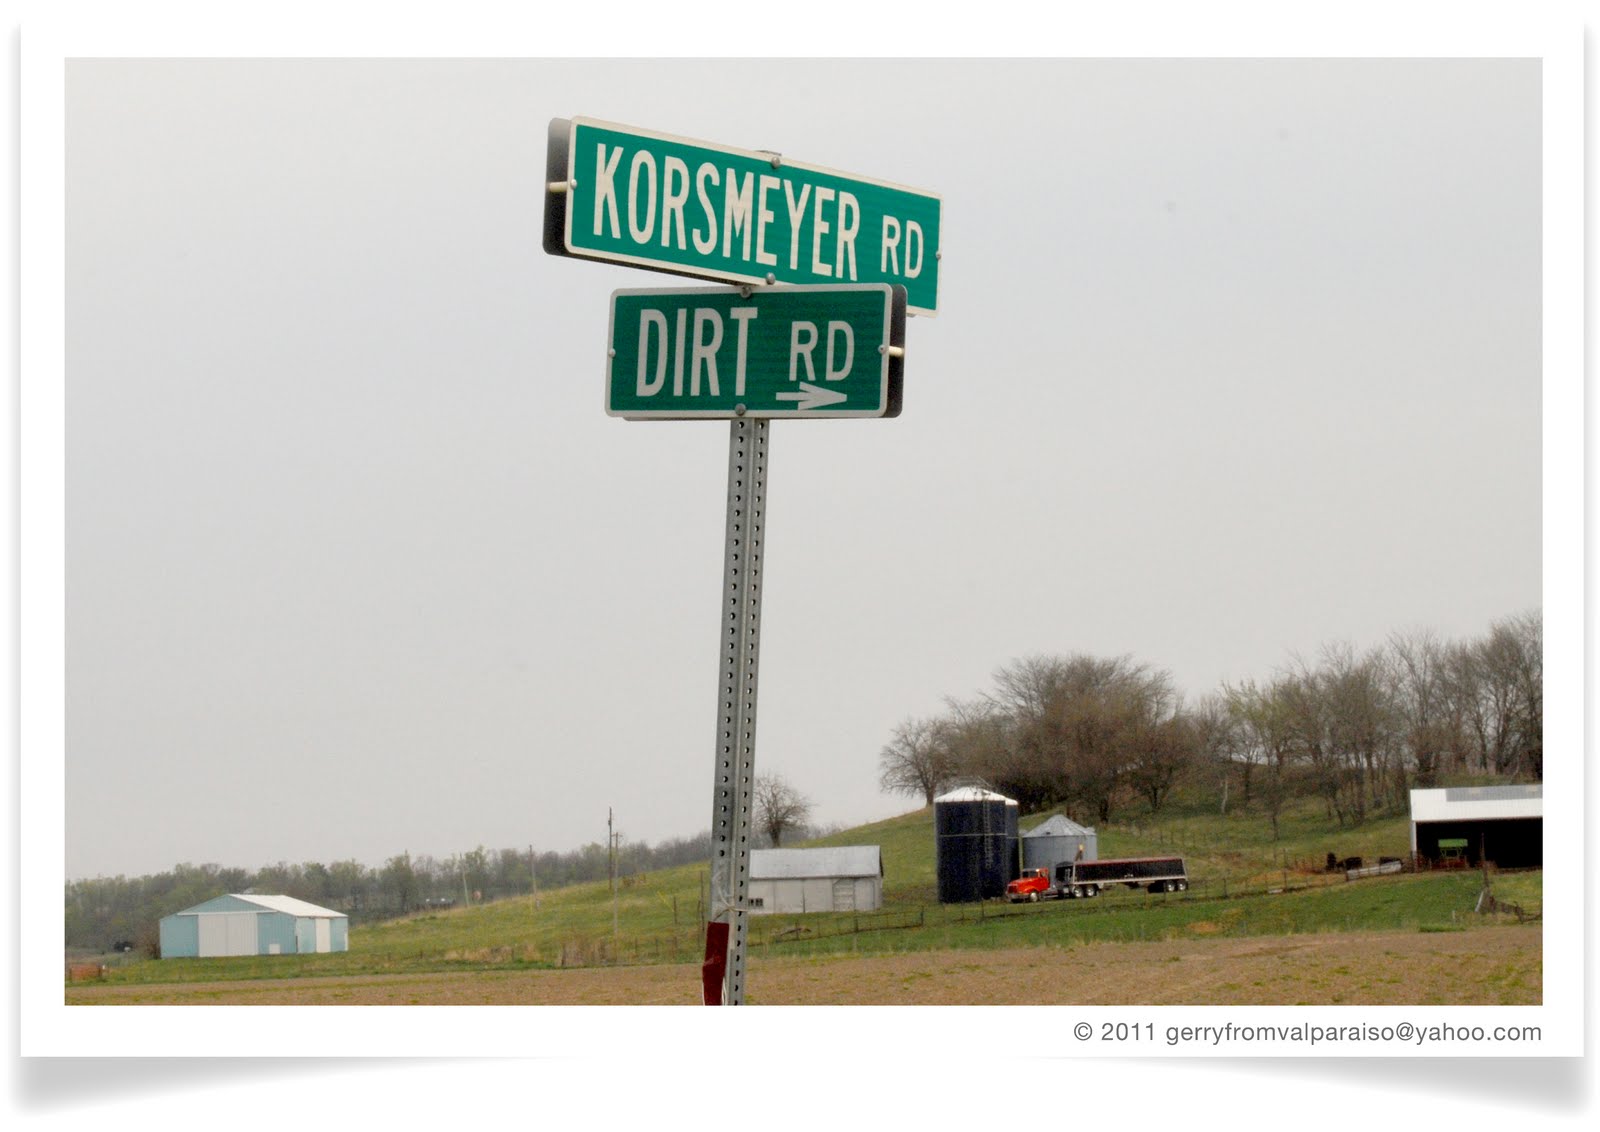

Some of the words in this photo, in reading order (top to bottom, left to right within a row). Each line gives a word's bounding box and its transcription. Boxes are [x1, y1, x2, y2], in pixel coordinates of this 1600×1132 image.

[593, 143, 861, 281] KORSMEYER
[881, 215, 924, 279] RD
[636, 307, 758, 397] DIRT
[789, 320, 855, 382] RD
